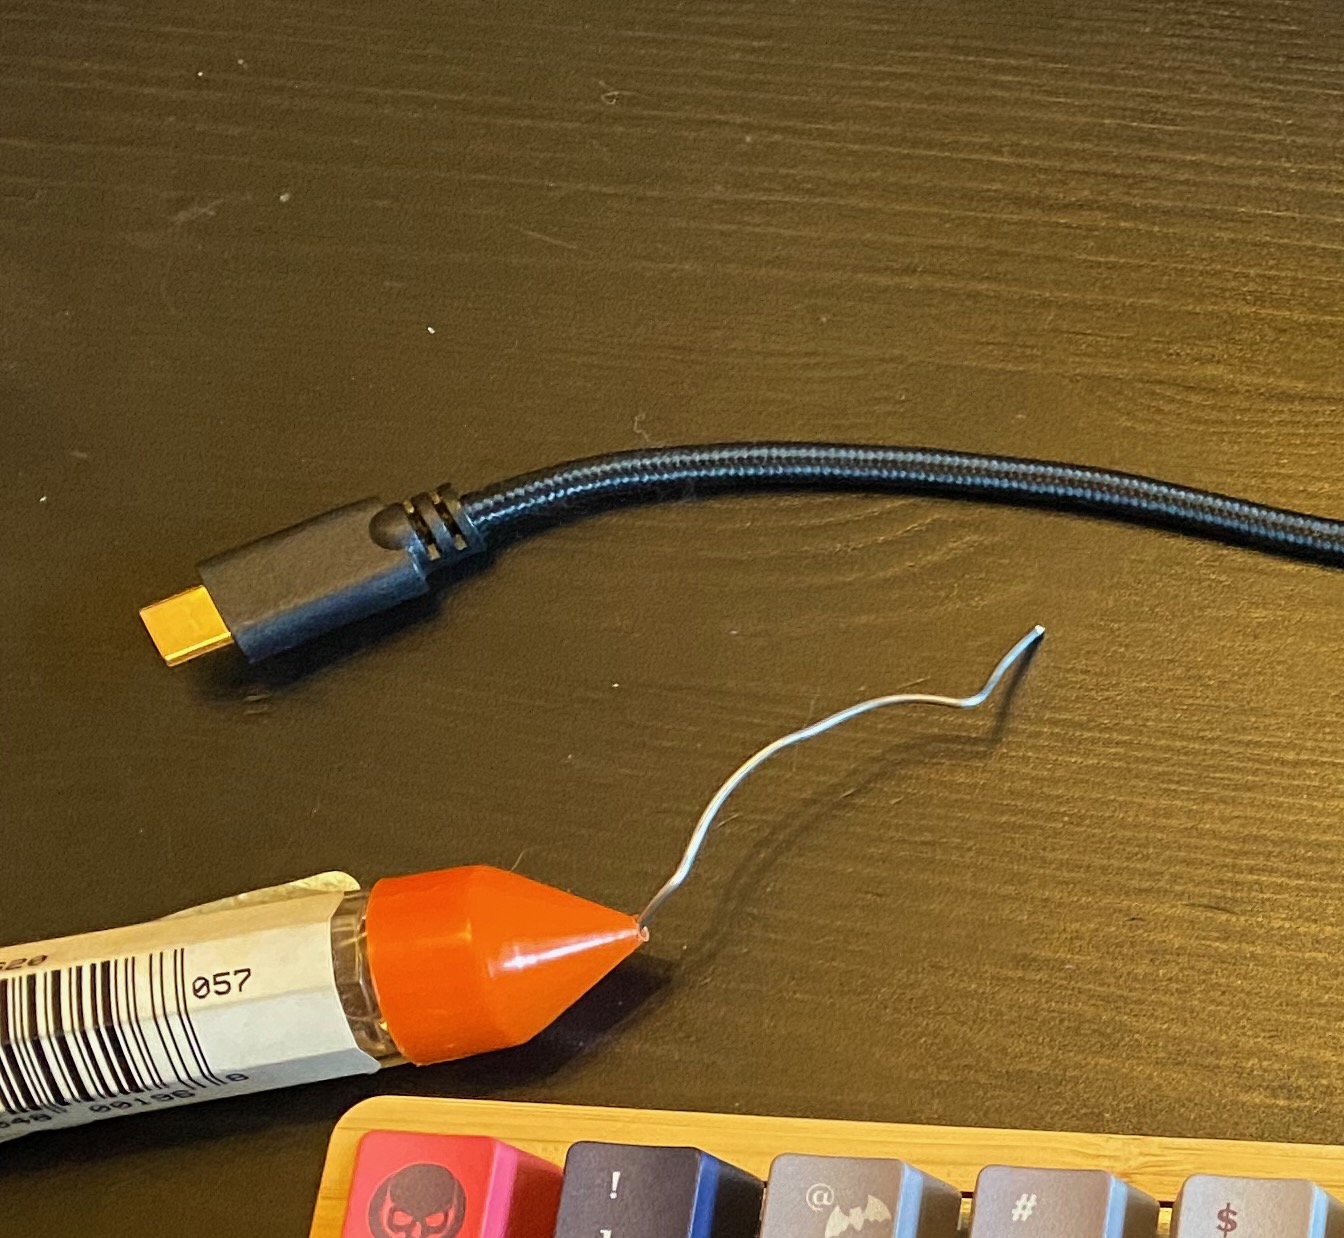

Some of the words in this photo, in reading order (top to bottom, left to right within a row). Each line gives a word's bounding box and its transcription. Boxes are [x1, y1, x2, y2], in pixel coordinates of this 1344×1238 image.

[192, 968, 251, 999] 057
[609, 1171, 621, 1199] !
[805, 1182, 835, 1211] @
[1011, 1193, 1037, 1222] #
[1216, 1202, 1238, 1238] $
